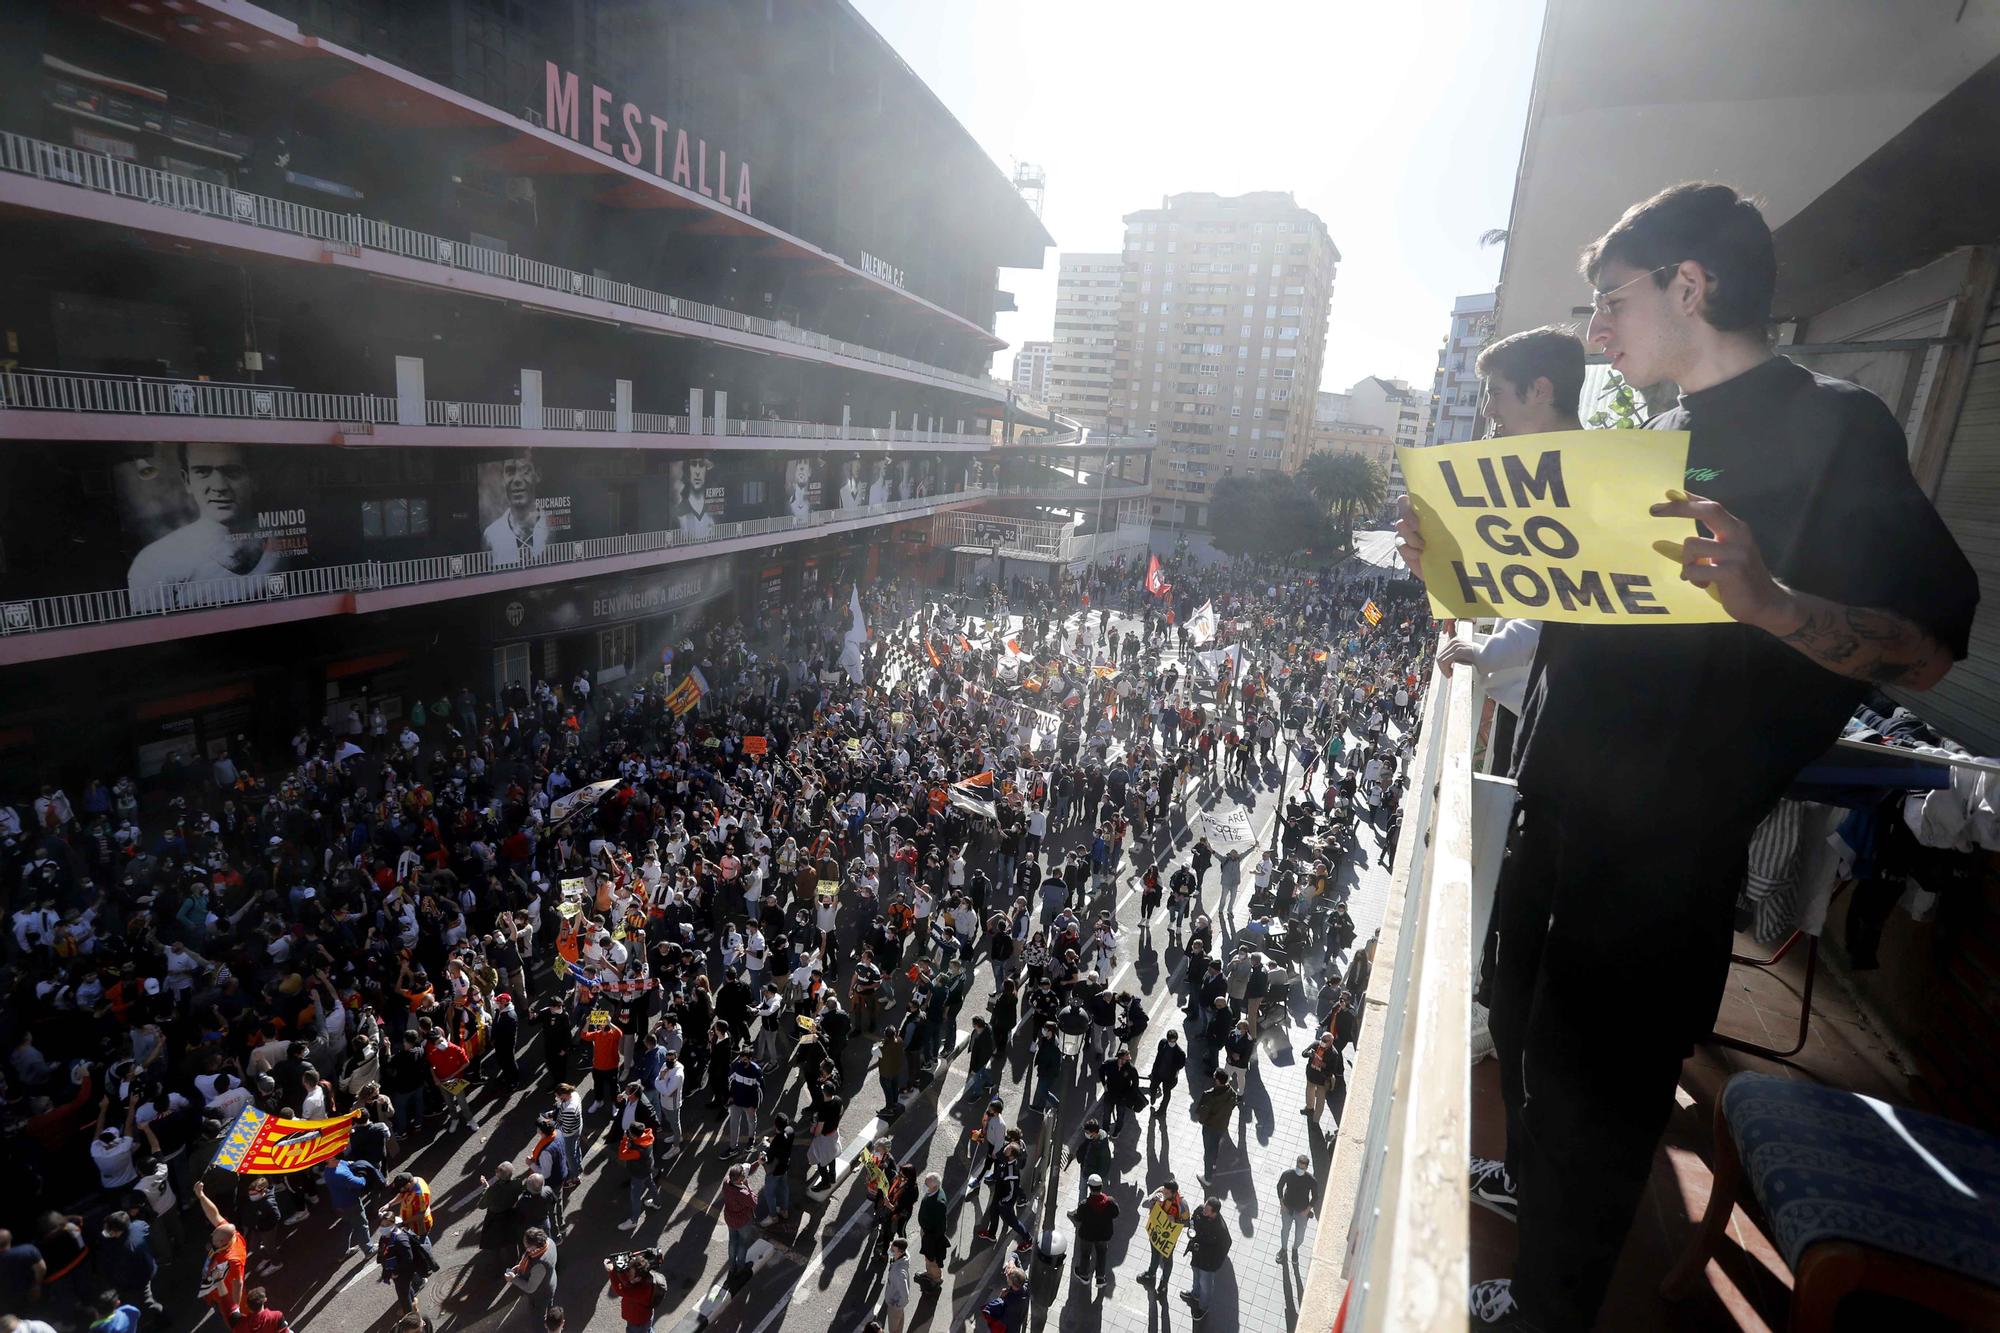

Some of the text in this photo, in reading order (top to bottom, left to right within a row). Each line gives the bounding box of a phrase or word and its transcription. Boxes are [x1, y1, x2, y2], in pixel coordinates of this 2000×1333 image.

[545, 59, 752, 215] MESTALLA
[860, 249, 905, 289] VALENCIA C.F.
[1438, 449, 1571, 508] LIM
[257, 508, 306, 528] MUNDO
[274, 529, 285, 537] AND
[285, 527, 307, 536] LEGEND
[1005, 529, 1015, 540] 52
[1474, 514, 1580, 560] GO
[592, 582, 702, 617] BENVINGUTS A MESTALLA
[1451, 559, 1670, 615] HOME
[1228, 811, 1246, 824] ARE
[1155, 1224, 1171, 1239] GO
[1156, 1210, 1178, 1233] LIM
[1147, 1222, 1174, 1255] HOME
